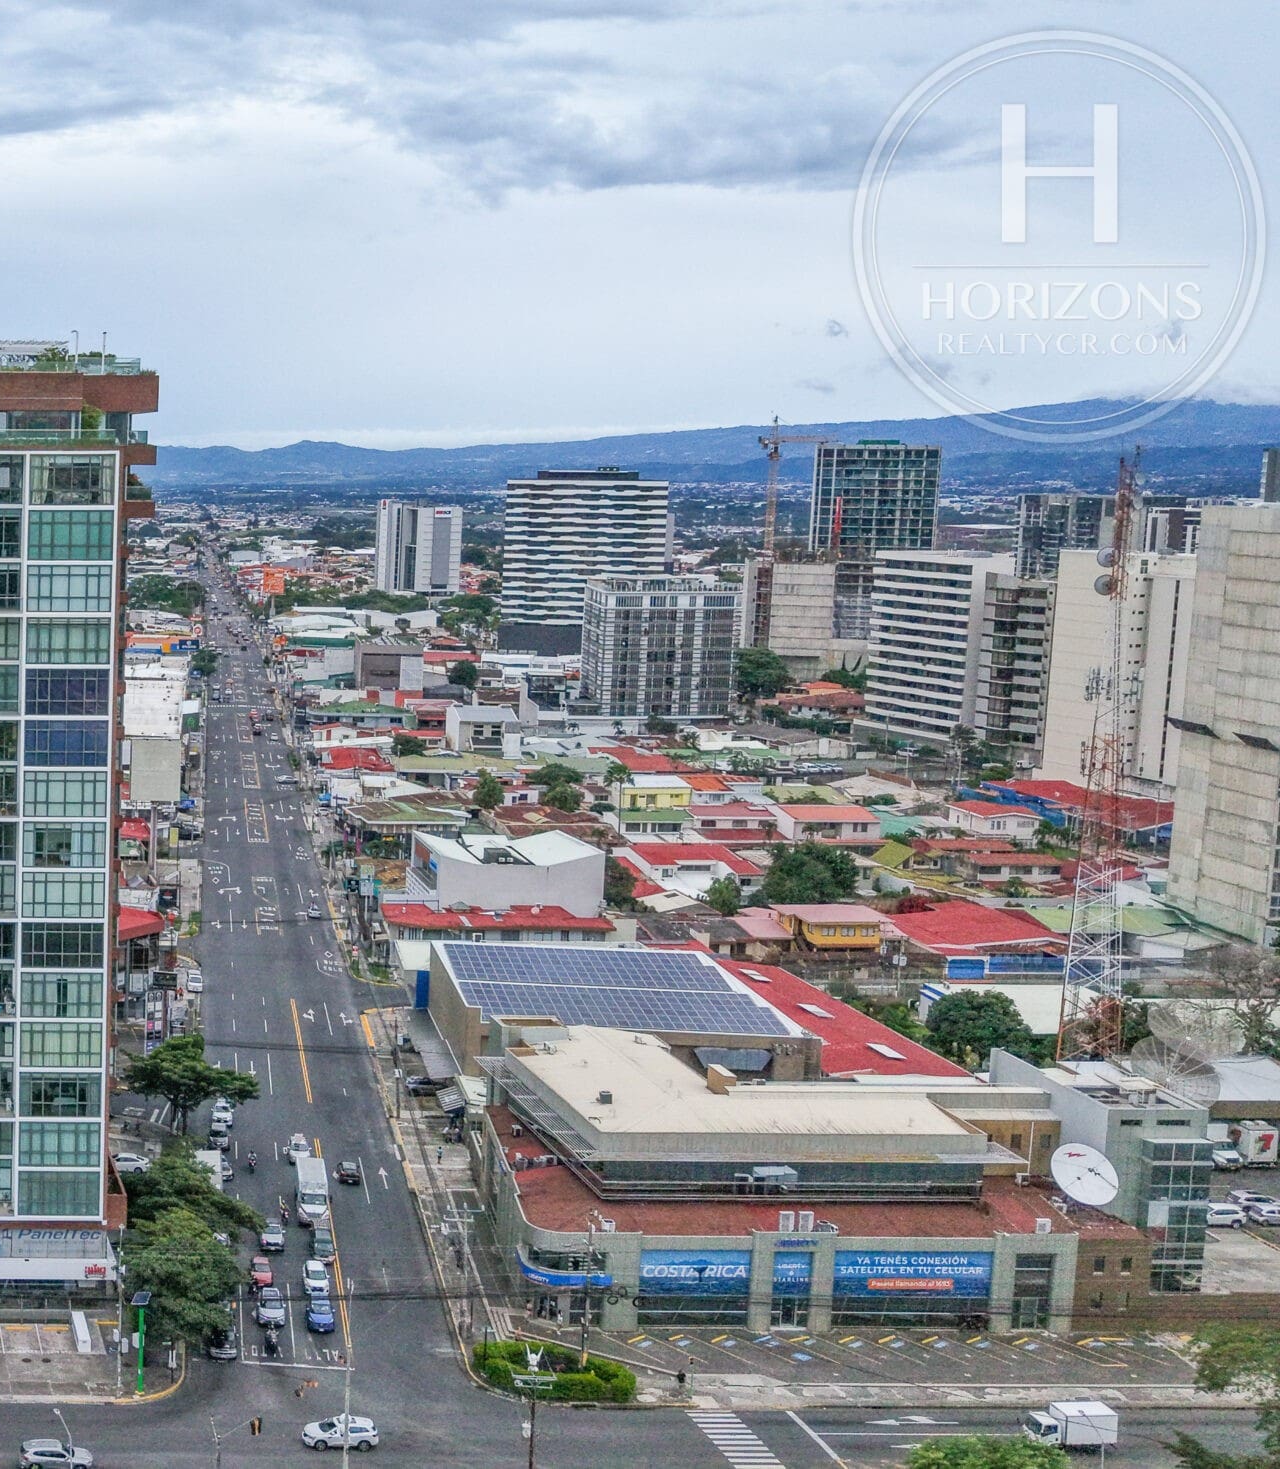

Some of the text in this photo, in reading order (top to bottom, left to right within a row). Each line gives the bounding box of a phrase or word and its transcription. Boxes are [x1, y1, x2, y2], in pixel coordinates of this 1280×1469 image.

[18, 1229, 102, 1240] PanelTec
[856, 1254, 968, 1265] YA TENÉS CONEXIÓN
[642, 1265, 747, 1278] COSTA RICA
[840, 1266, 984, 1275] SATELITAL EN TU CELULAR
